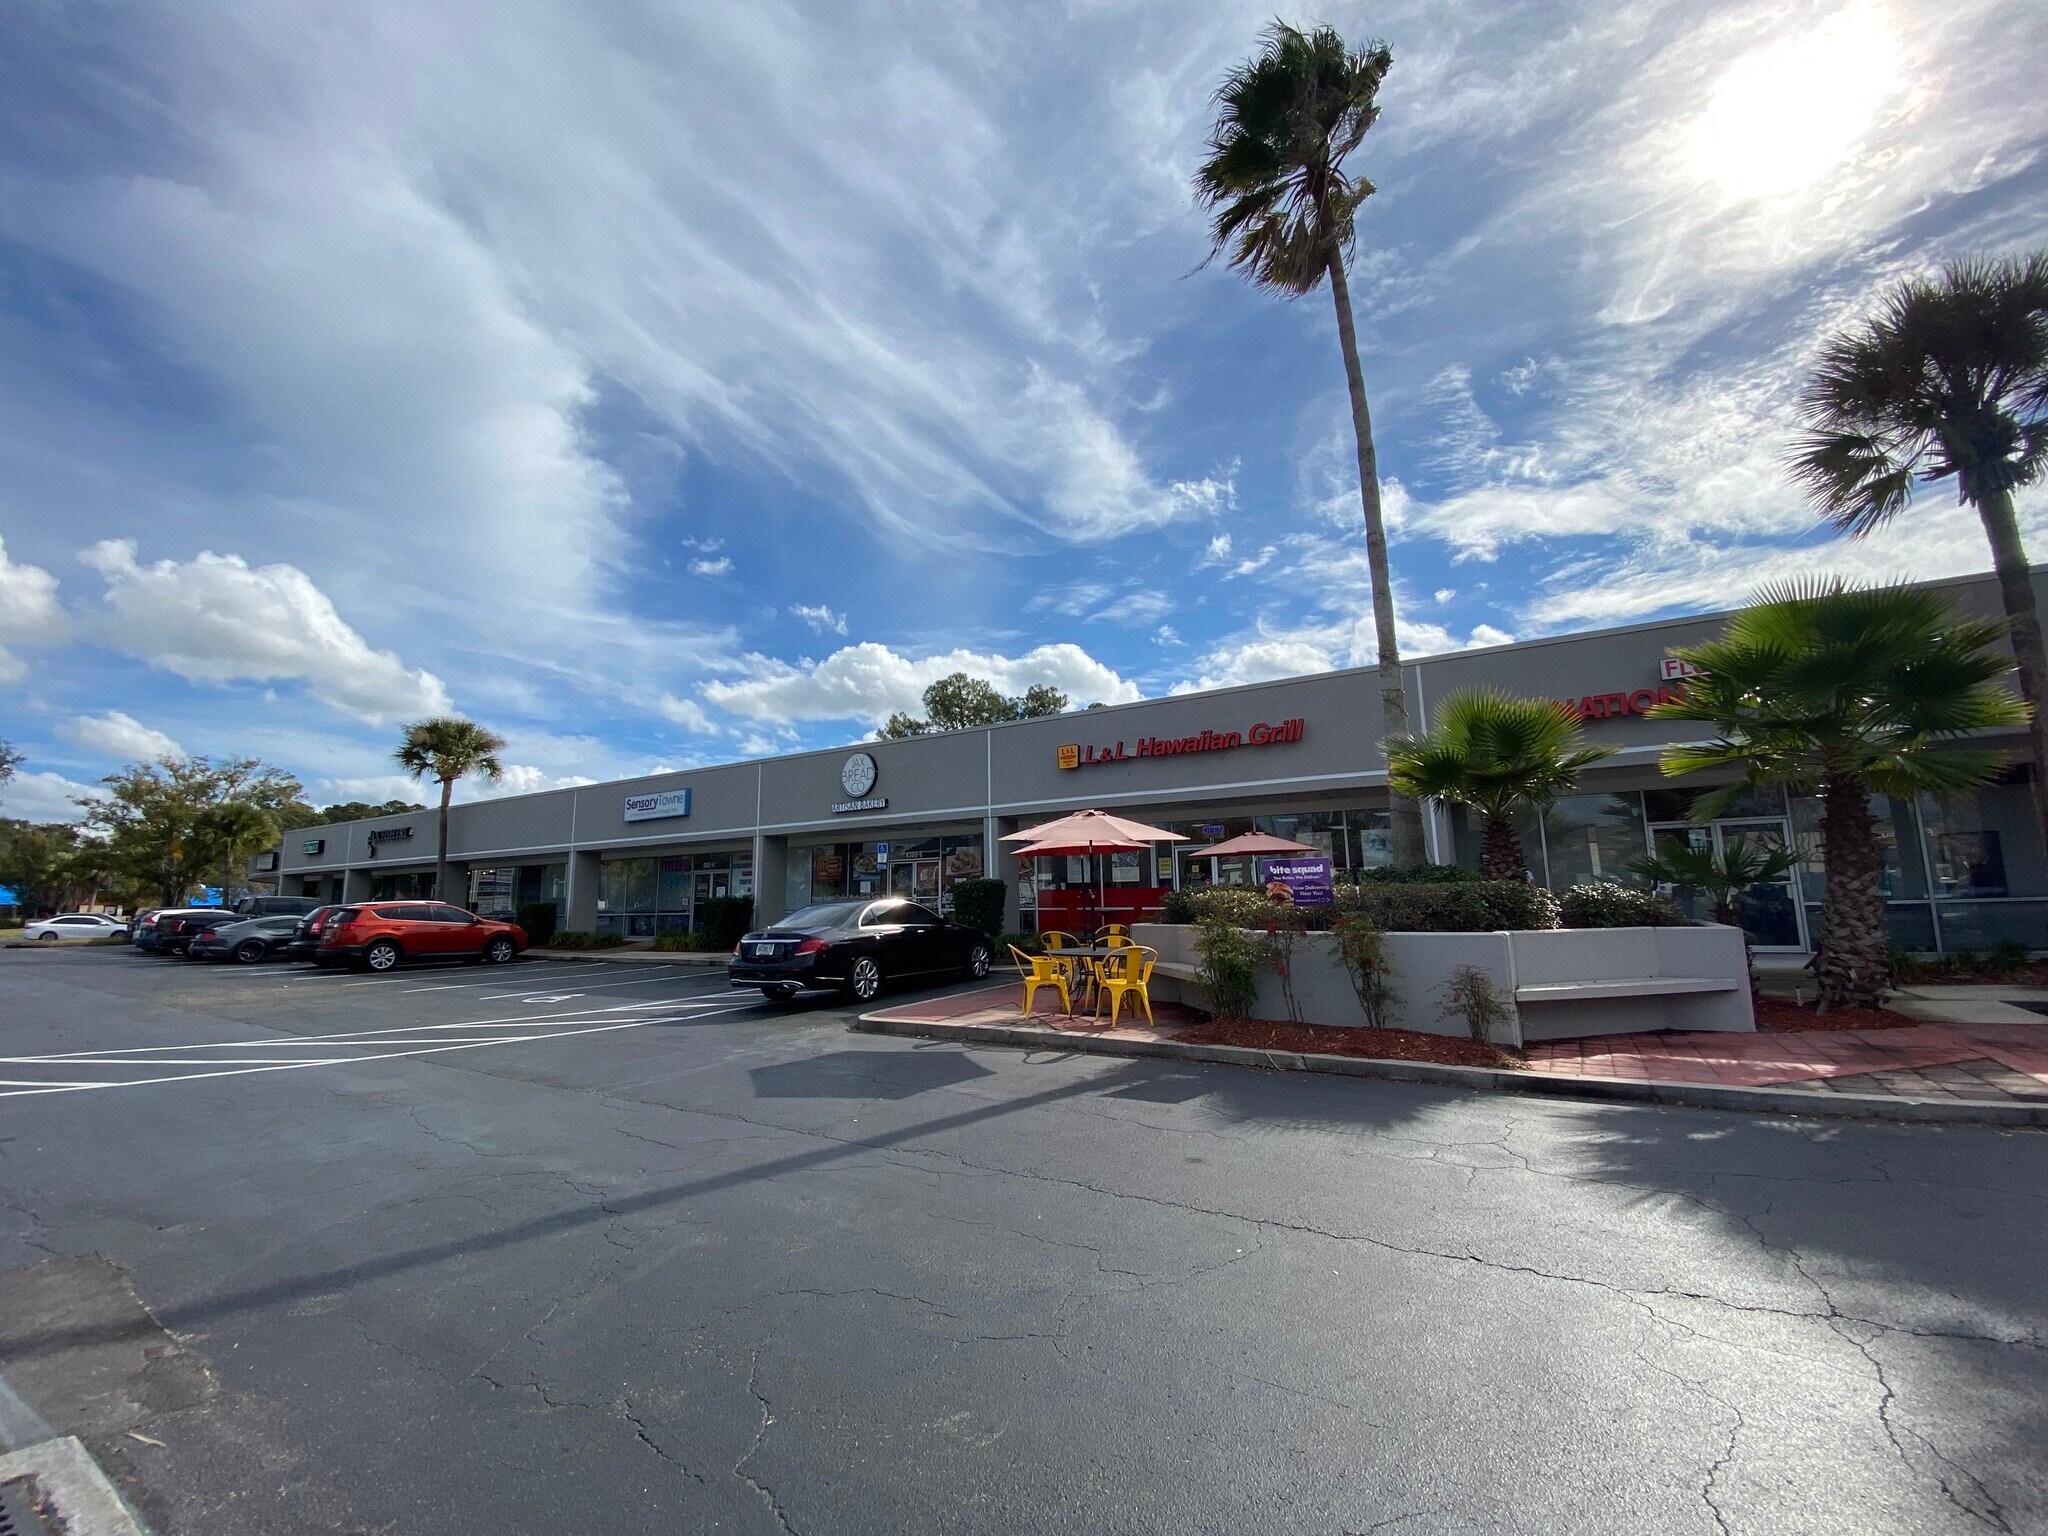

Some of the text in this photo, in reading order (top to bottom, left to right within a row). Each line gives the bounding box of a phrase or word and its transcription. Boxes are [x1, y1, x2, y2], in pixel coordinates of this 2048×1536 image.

[1135, 729, 1242, 758] Hawaiian
[1248, 718, 1306, 748] Grill
[851, 757, 865, 768] JAX
[842, 767, 874, 783] BREAD
[851, 782, 865, 793] CO
[832, 798, 886, 813] ARTISAN BAKERY
[1269, 864, 1323, 875] bite squad
